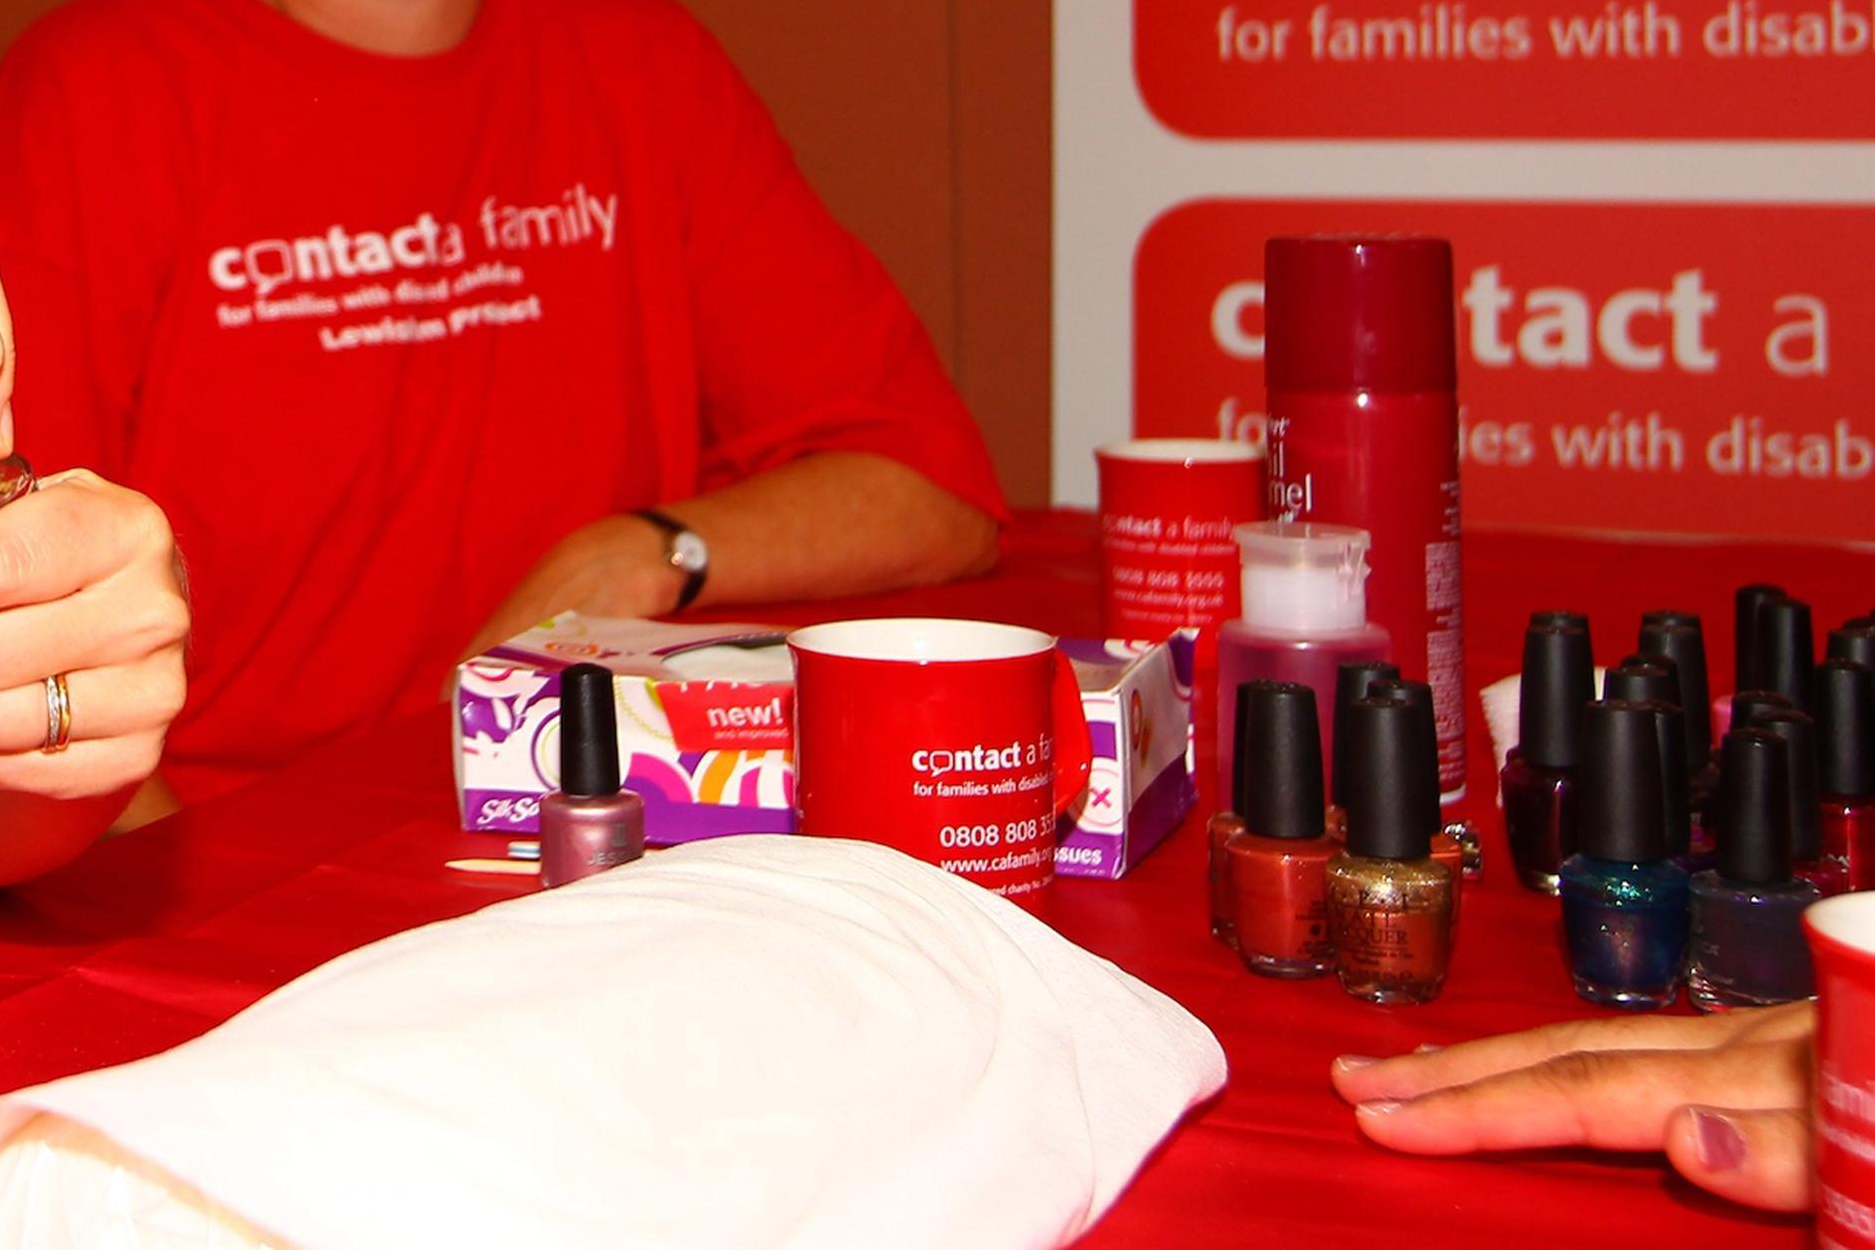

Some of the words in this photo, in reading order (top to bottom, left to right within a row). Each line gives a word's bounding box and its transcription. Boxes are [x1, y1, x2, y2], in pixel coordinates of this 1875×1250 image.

[1216, 4, 1293, 61] for
[1309, 2, 1531, 61] families
[1549, 0, 1681, 58] with
[209, 212, 439, 296] contact
[480, 183, 618, 250] family
[1211, 263, 1719, 374] ctact
[1765, 293, 1829, 378] a
[1217, 397, 1267, 445] fo
[1551, 410, 1685, 472] with
[707, 697, 785, 728] new!
[912, 741, 1022, 777] contact
[1026, 744, 1035, 765] a
[913, 780, 933, 797] for
[937, 780, 989, 798] families
[992, 778, 1016, 795] with
[940, 825, 1000, 847] 0808
[1005, 820, 1037, 843] 808
